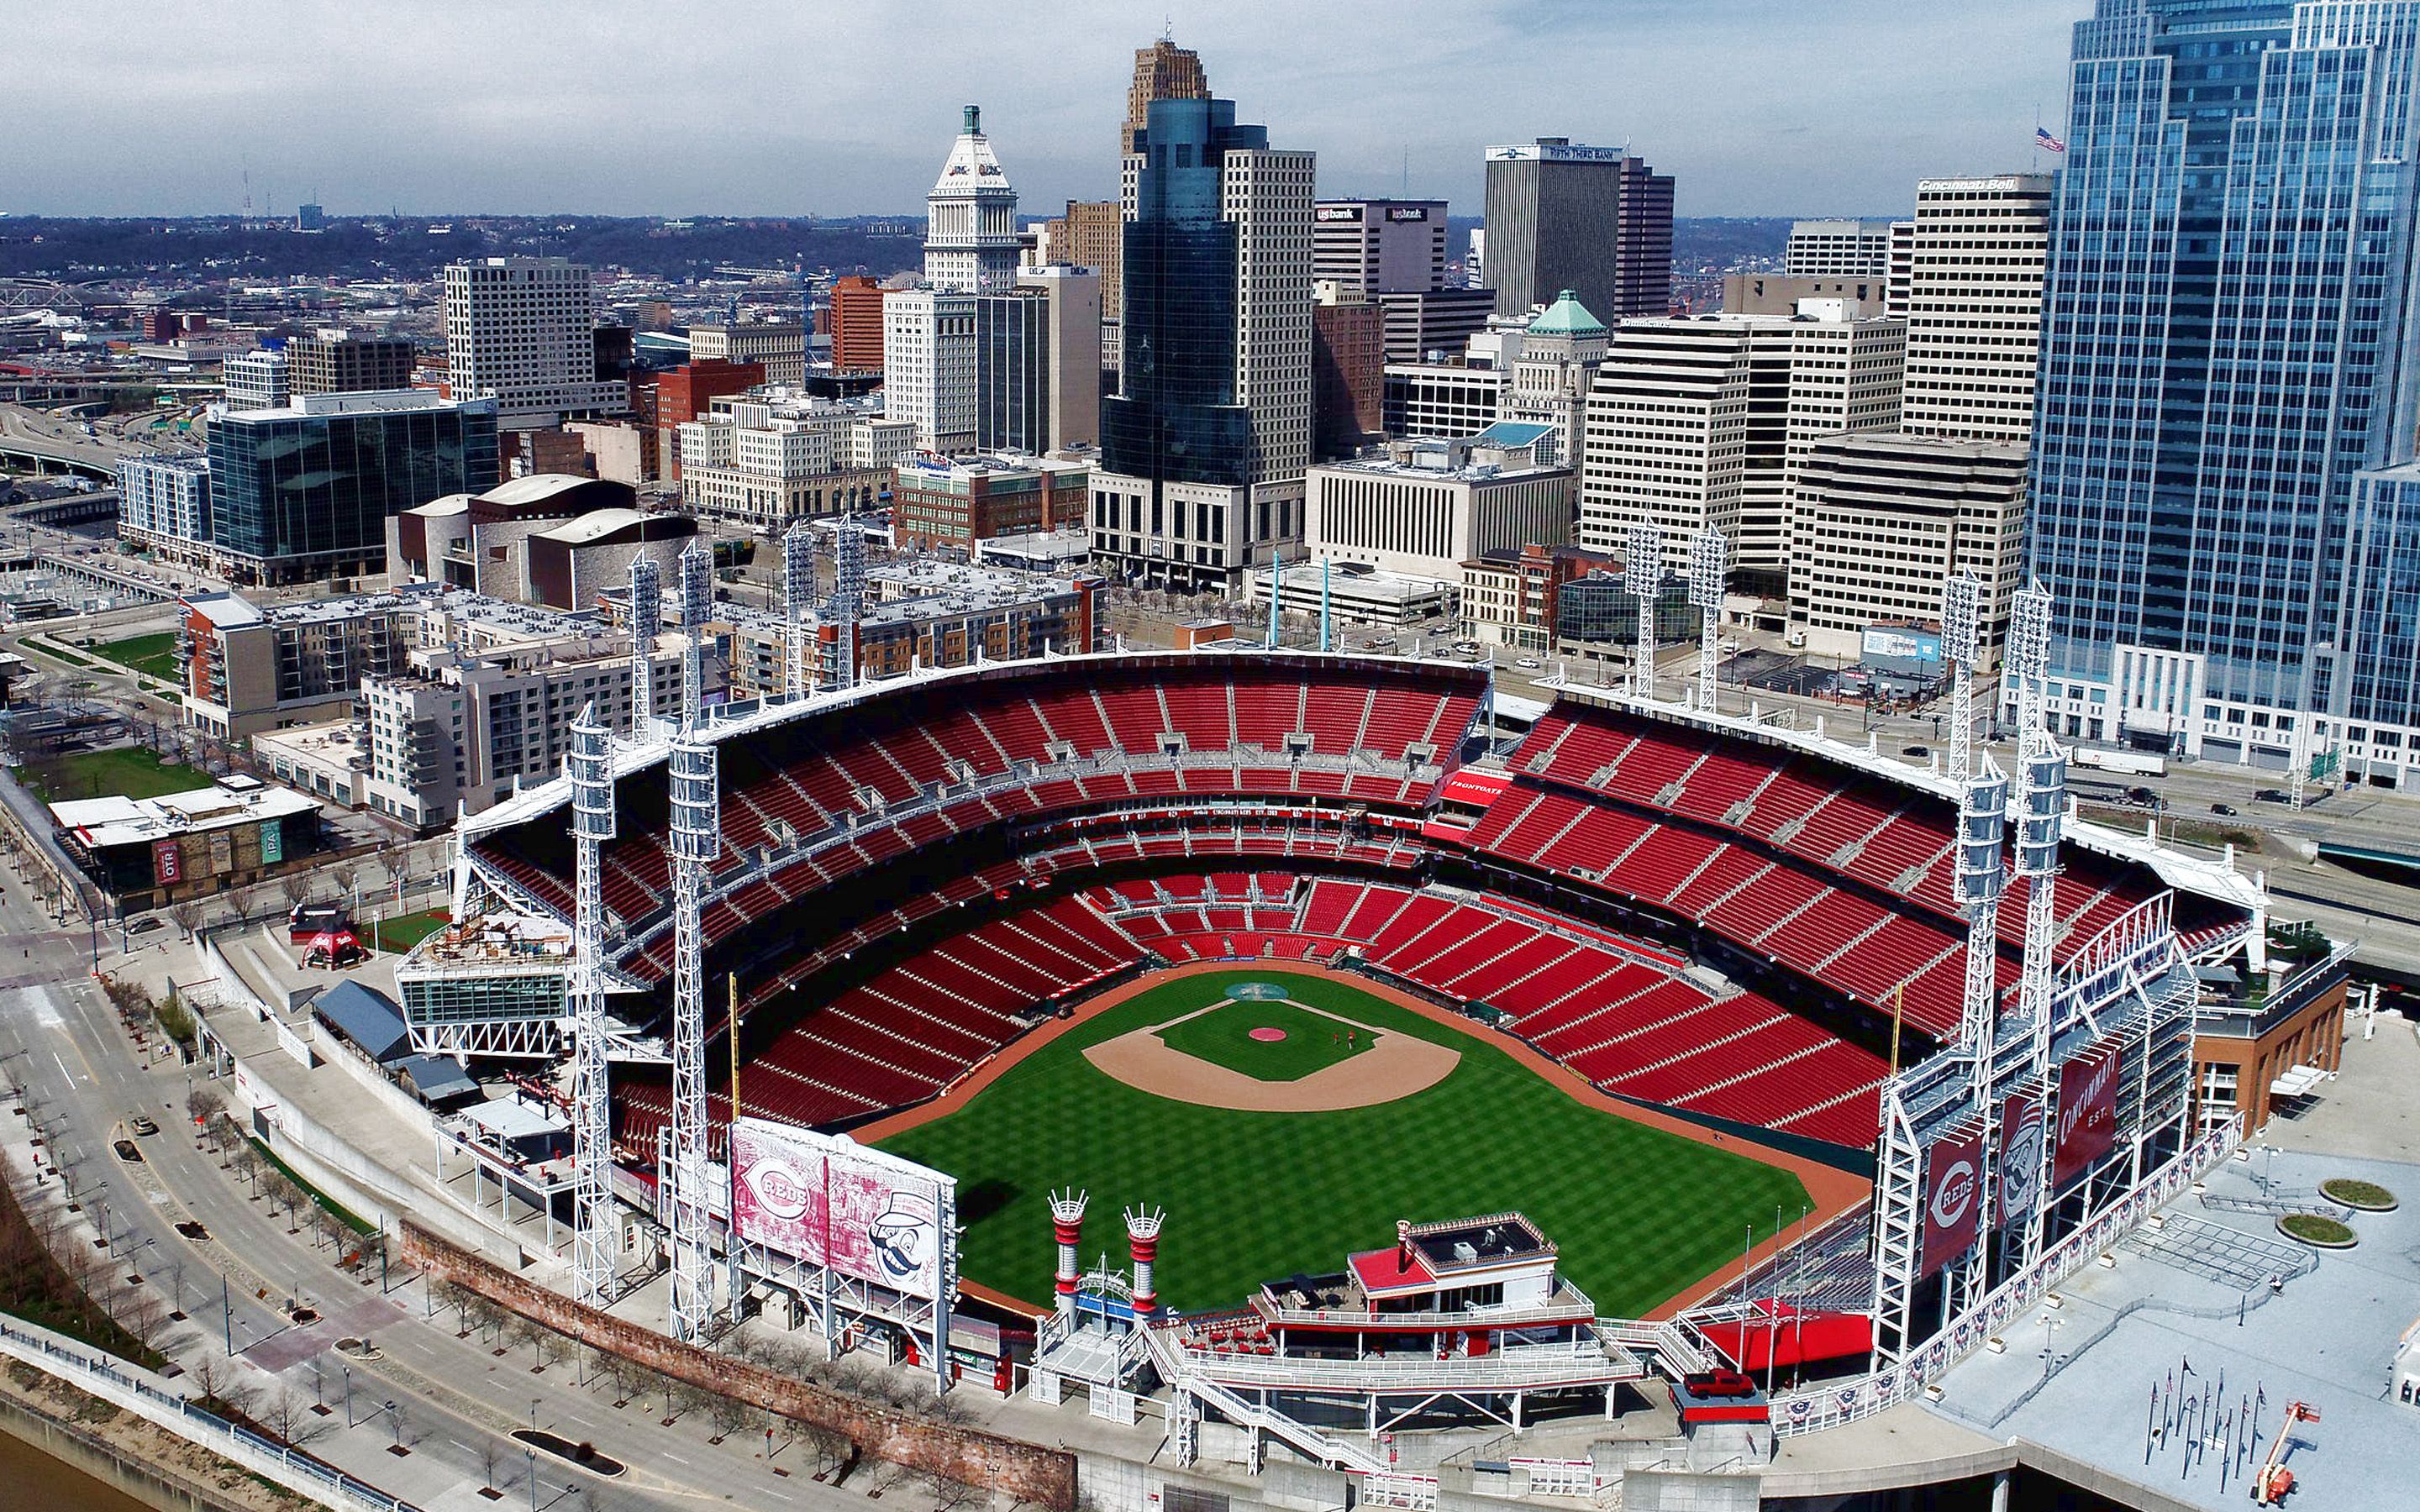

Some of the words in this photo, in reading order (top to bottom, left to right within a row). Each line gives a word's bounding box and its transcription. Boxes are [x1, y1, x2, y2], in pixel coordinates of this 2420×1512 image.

[1550, 149, 1570, 159] FIFTH
[1572, 150, 1592, 159] THIRD
[1595, 150, 1613, 160] BANK
[1918, 180, 1984, 192] Cincinnati
[1986, 179, 2015, 191] Bell
[1450, 780, 1503, 795] FRONTGATE
[267, 833, 276, 854] IPA
[166, 853, 175, 876] OTR
[2061, 1049, 2117, 1146] CINCINNATI
[2087, 1106, 2108, 1127] EST.
[763, 1179, 808, 1206] REDS
[1942, 1176, 1974, 1209] REDS
